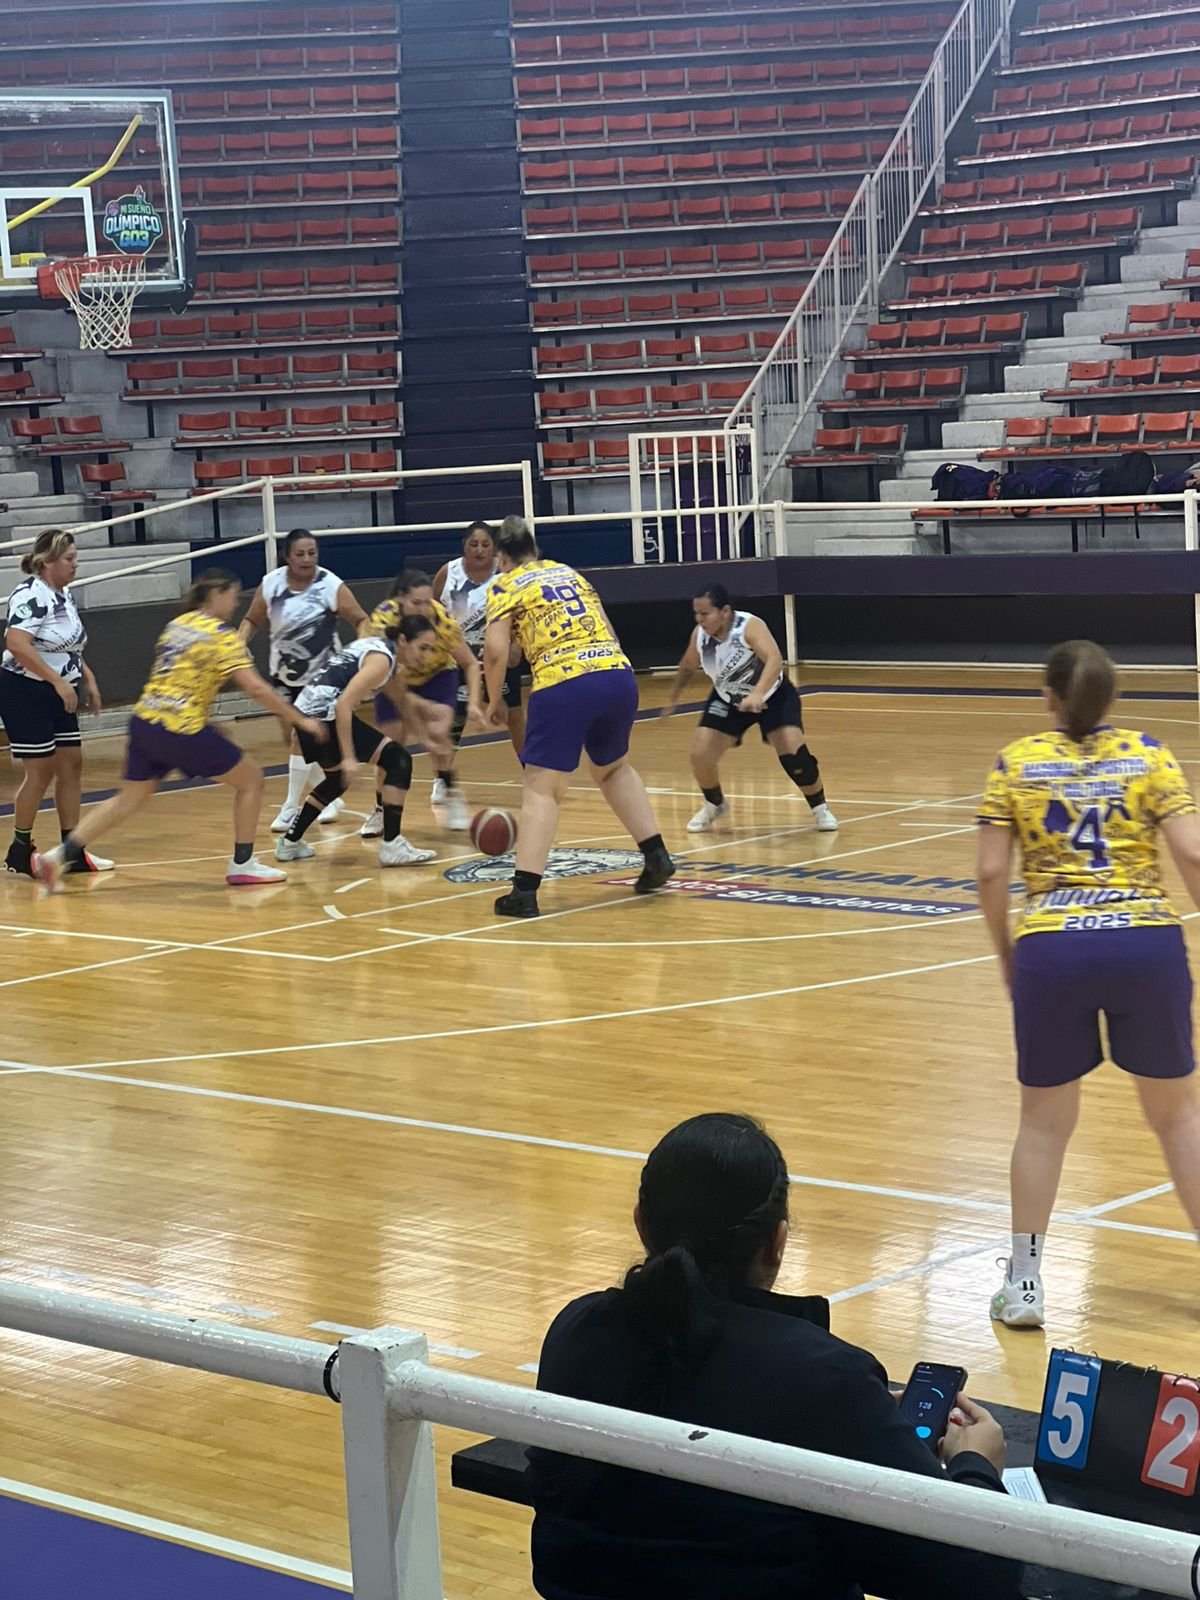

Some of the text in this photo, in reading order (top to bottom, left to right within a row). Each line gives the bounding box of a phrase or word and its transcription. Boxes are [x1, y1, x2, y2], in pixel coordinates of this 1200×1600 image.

[107, 214, 160, 233] OLÍMPICO
[578, 648, 613, 660] 2025
[1072, 805, 1111, 870] 4
[1065, 912, 1131, 930] 2025
[918, 1401, 932, 1410] 1:28
[1047, 1371, 1090, 1459] 5
[1147, 1396, 1199, 1488] 2
